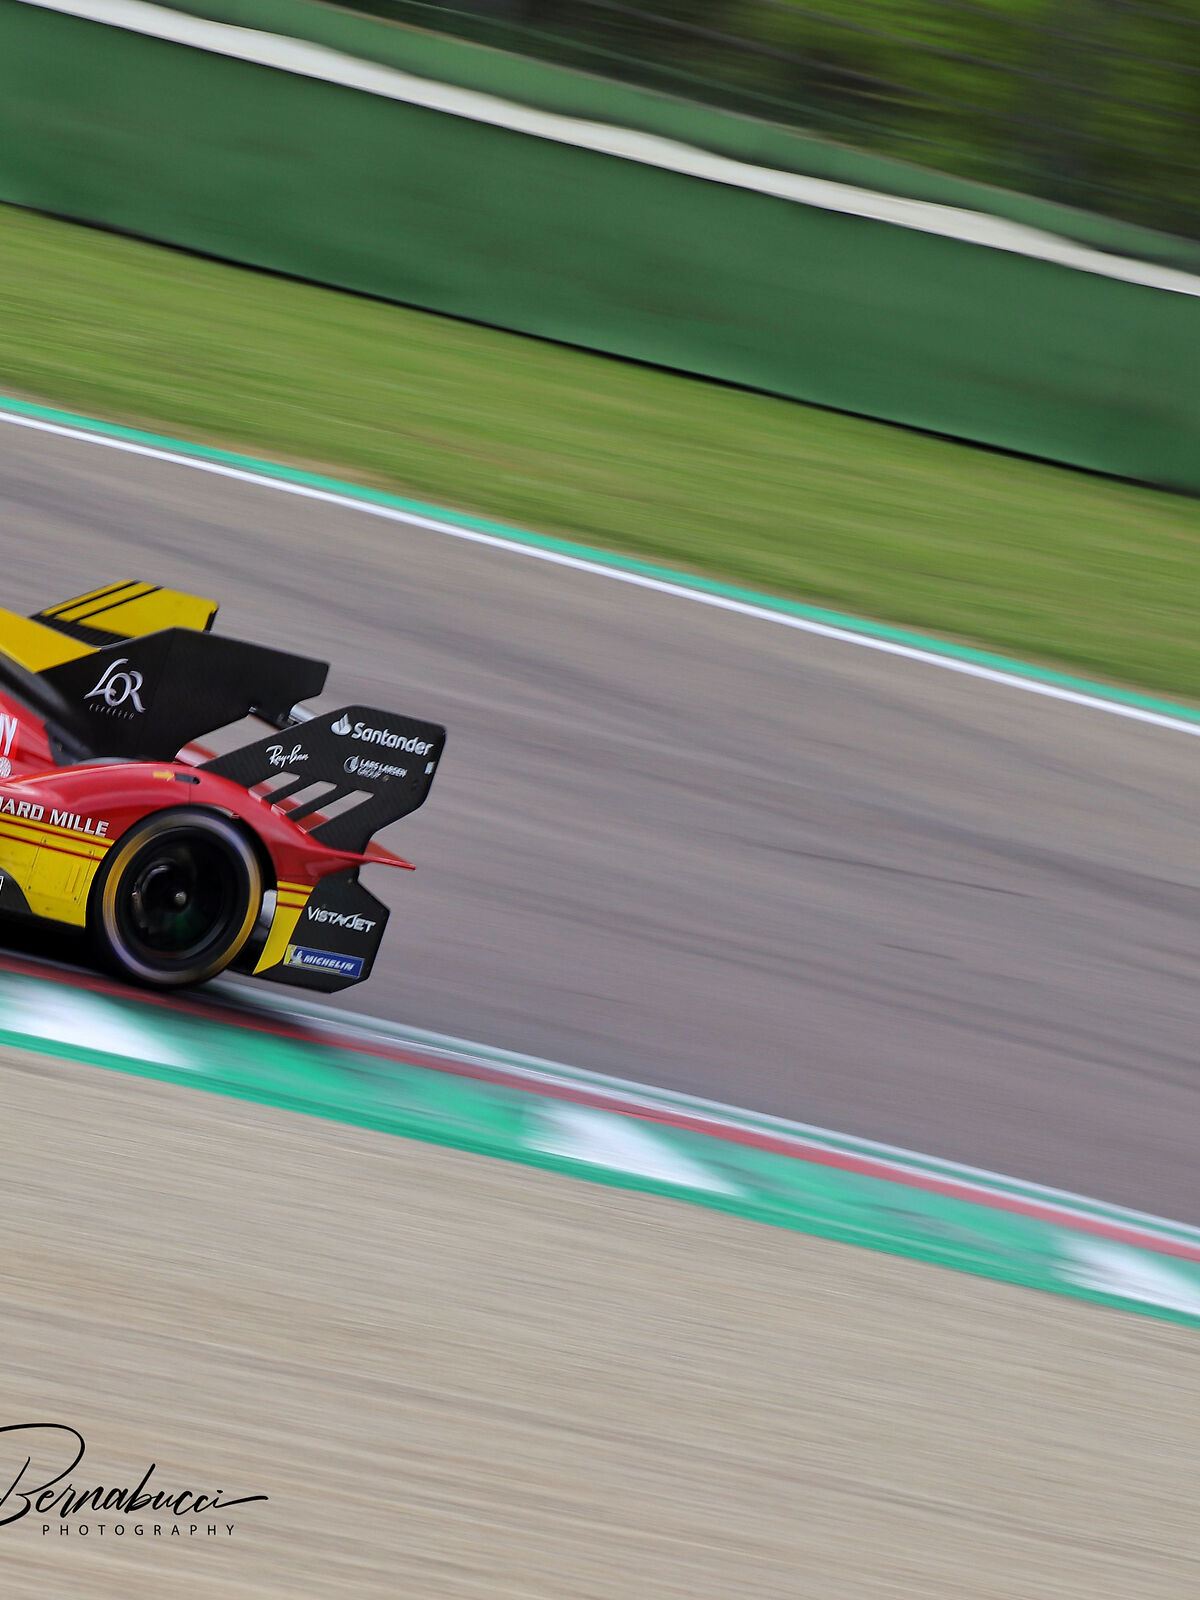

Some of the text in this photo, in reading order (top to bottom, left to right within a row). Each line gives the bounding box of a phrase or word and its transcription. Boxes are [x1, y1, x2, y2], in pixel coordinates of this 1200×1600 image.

[351, 722, 433, 756] Santander
[50, 809, 109, 838] MILLE
[307, 906, 376, 932] VISTAJET
[303, 955, 355, 971] MICHELIN
